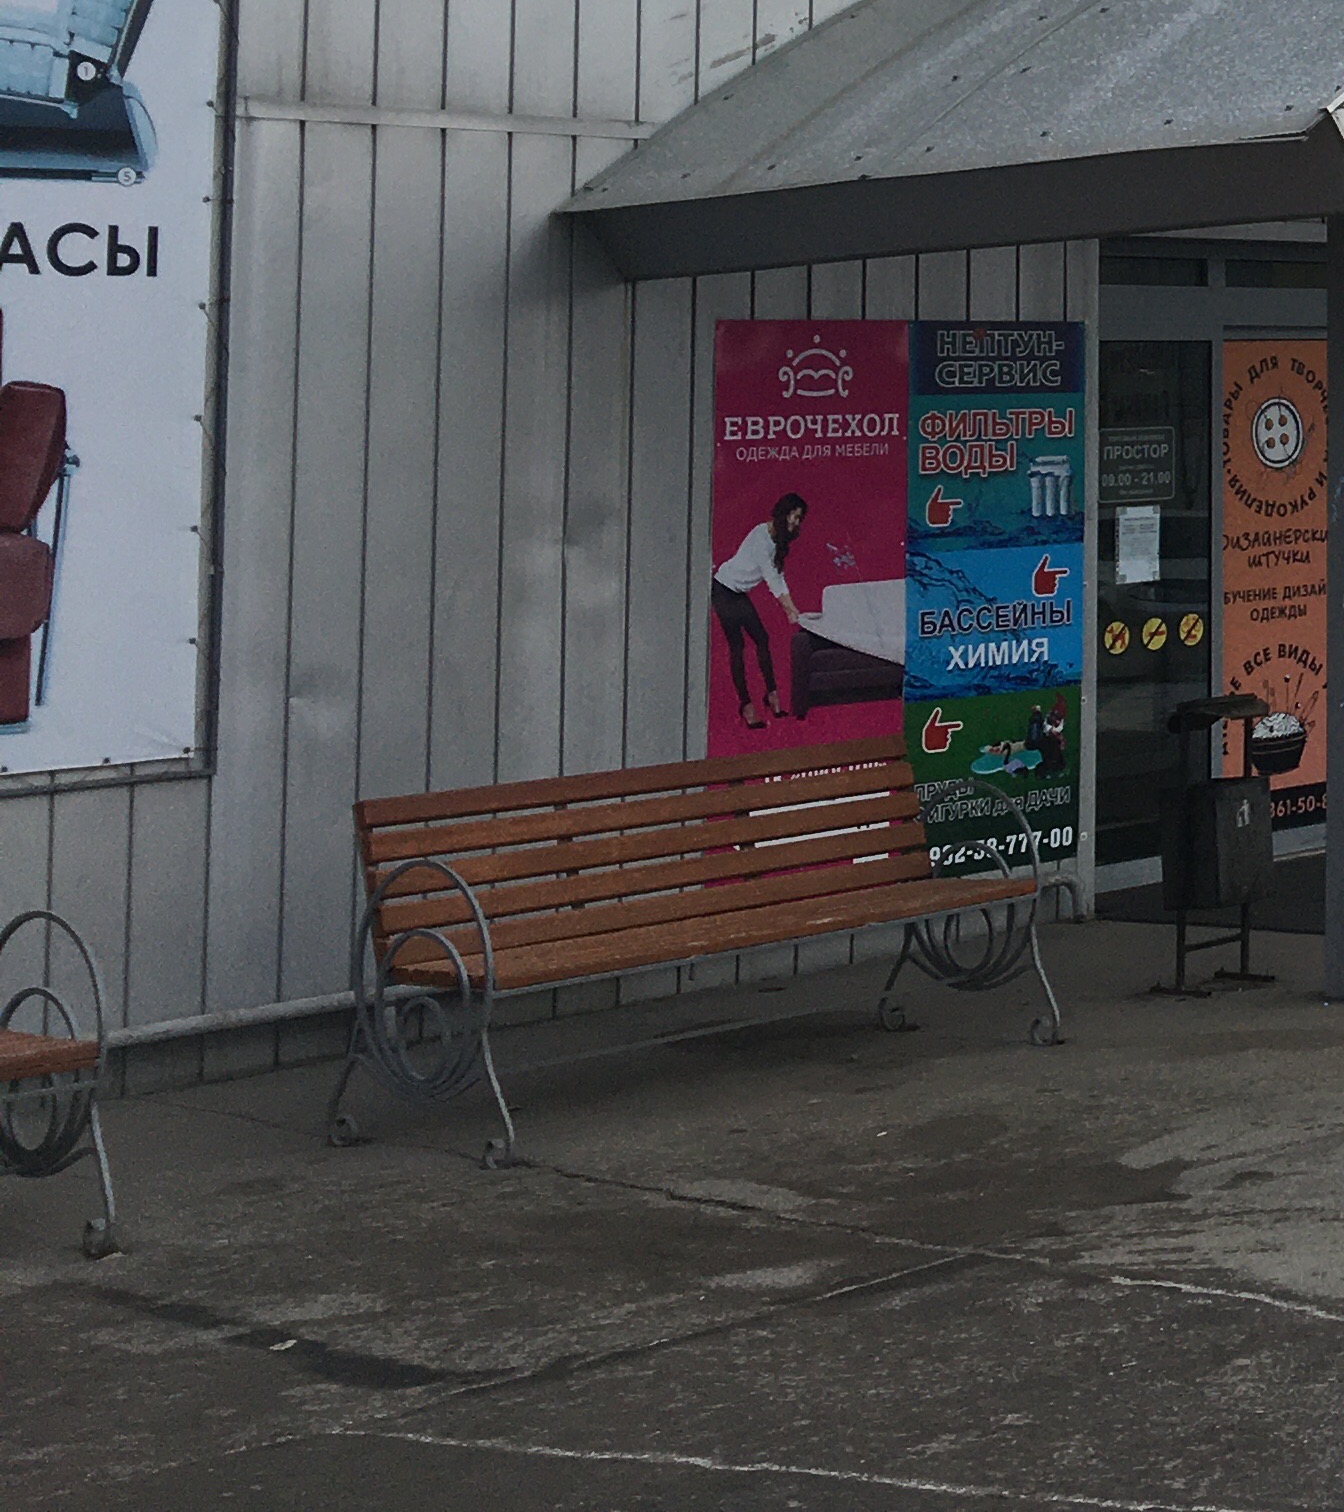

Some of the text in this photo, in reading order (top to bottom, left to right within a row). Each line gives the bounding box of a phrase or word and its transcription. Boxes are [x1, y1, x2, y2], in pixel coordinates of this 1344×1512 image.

[937, 330, 1065, 356] НЕПТУН-
[935, 361, 1061, 387] СЕРВИС
[1247, 355, 1279, 385] ДЛЯ
[723, 413, 900, 440] ЕВРОЧЕХОЛ
[919, 408, 1075, 441] ФИЛЬТРЫ
[735, 442, 889, 463] ОДЕЖДА ДЛЯ МЕБЕЛИ
[919, 441, 1017, 478] ВОДЫ
[1103, 443, 1169, 461] ПРОСТОР
[1141, 470, 1171, 486] 21.00
[1228, 474, 1317, 517] РУКОДЕЛИЯ
[1248, 550, 1311, 569] ШТУЧКИ
[1223, 578, 1327, 606] БУЧЕНИЕ ДИЗАЙ
[919, 599, 1072, 638] БАССЕЙНЫ
[1250, 605, 1307, 623] ОДЕЖДЫ
[946, 637, 1050, 671] ХИМИЯ
[1242, 643, 1323, 676] ВСЕ ВИДЫ
[914, 797, 991, 823] ИГУРКИ
[1025, 785, 1071, 813] ДАЧИ
